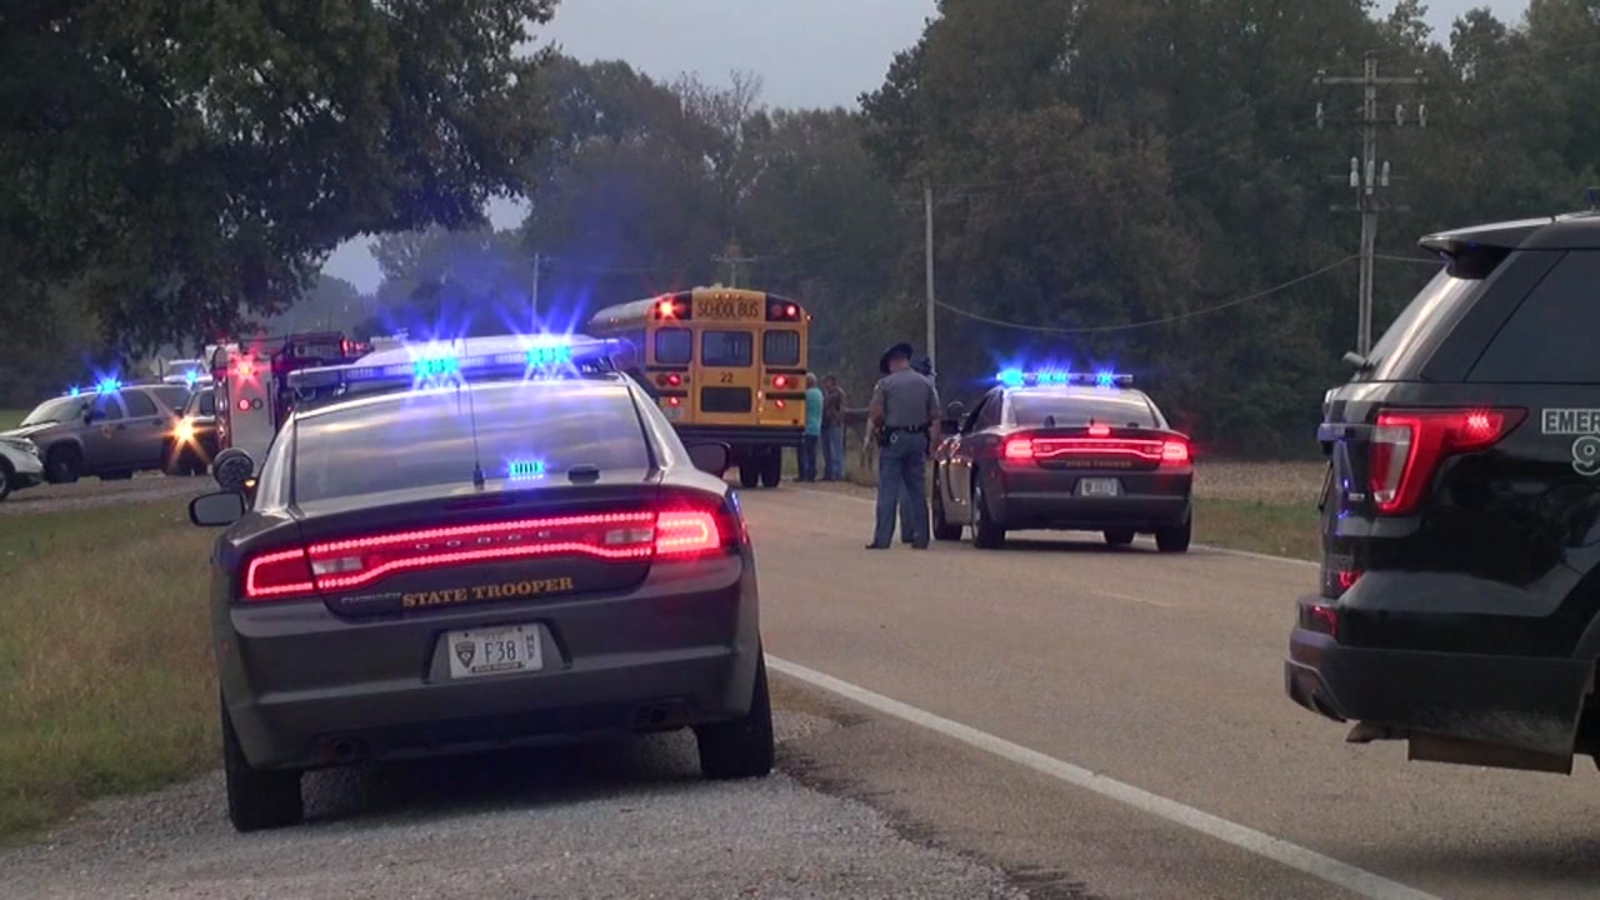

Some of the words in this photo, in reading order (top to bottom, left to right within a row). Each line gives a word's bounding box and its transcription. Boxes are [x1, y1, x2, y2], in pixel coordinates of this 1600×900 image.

[697, 300, 737, 318] SCHOOL
[739, 301, 759, 318] BUS
[720, 372, 734, 384] 22
[402, 588, 468, 607] STATE
[471, 577, 575, 600] TROOPER
[485, 640, 516, 663] F38
